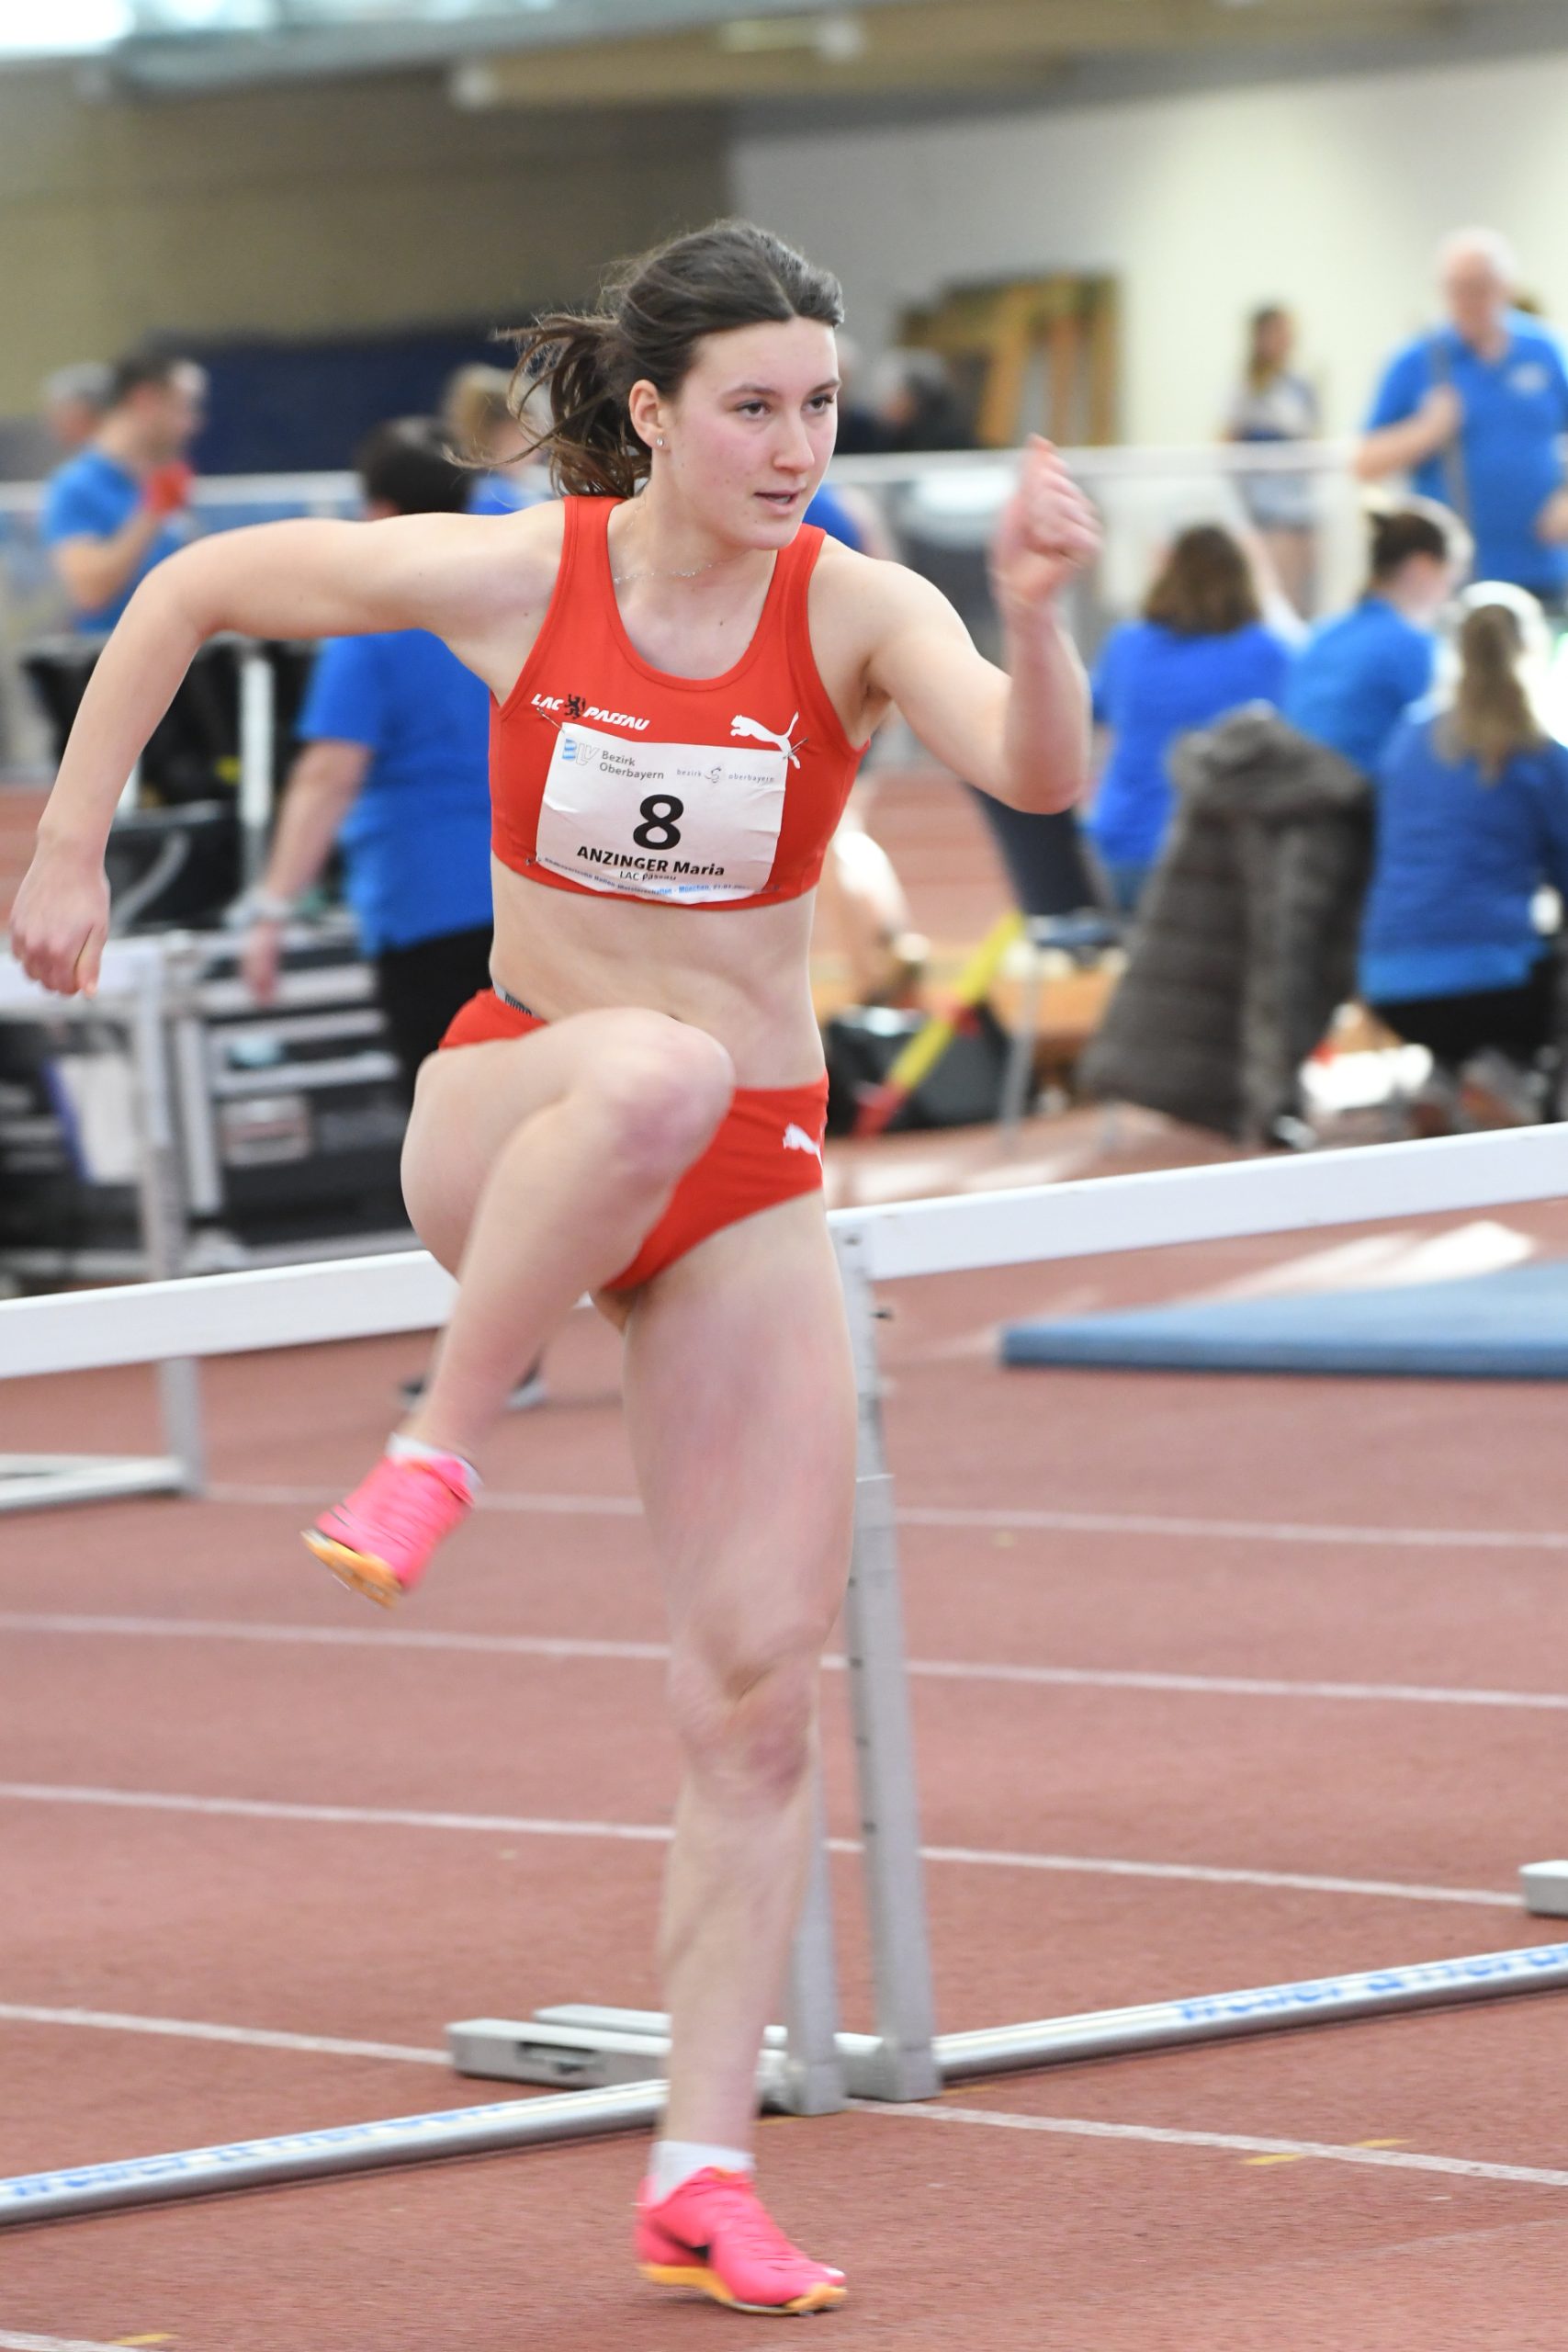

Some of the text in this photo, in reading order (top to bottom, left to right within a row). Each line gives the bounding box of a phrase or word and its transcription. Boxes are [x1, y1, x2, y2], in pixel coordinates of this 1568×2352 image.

[531, 693, 650, 731] LAC PASSAU
[602, 750, 636, 766] Bezirk
[600, 762, 664, 781] Oberbayern
[676, 768, 774, 784] bezirk oberbayern
[633, 794, 684, 850] 8
[577, 845, 669, 873] ANZINGER
[673, 861, 725, 876] Maria
[620, 870, 640, 881] LAC
